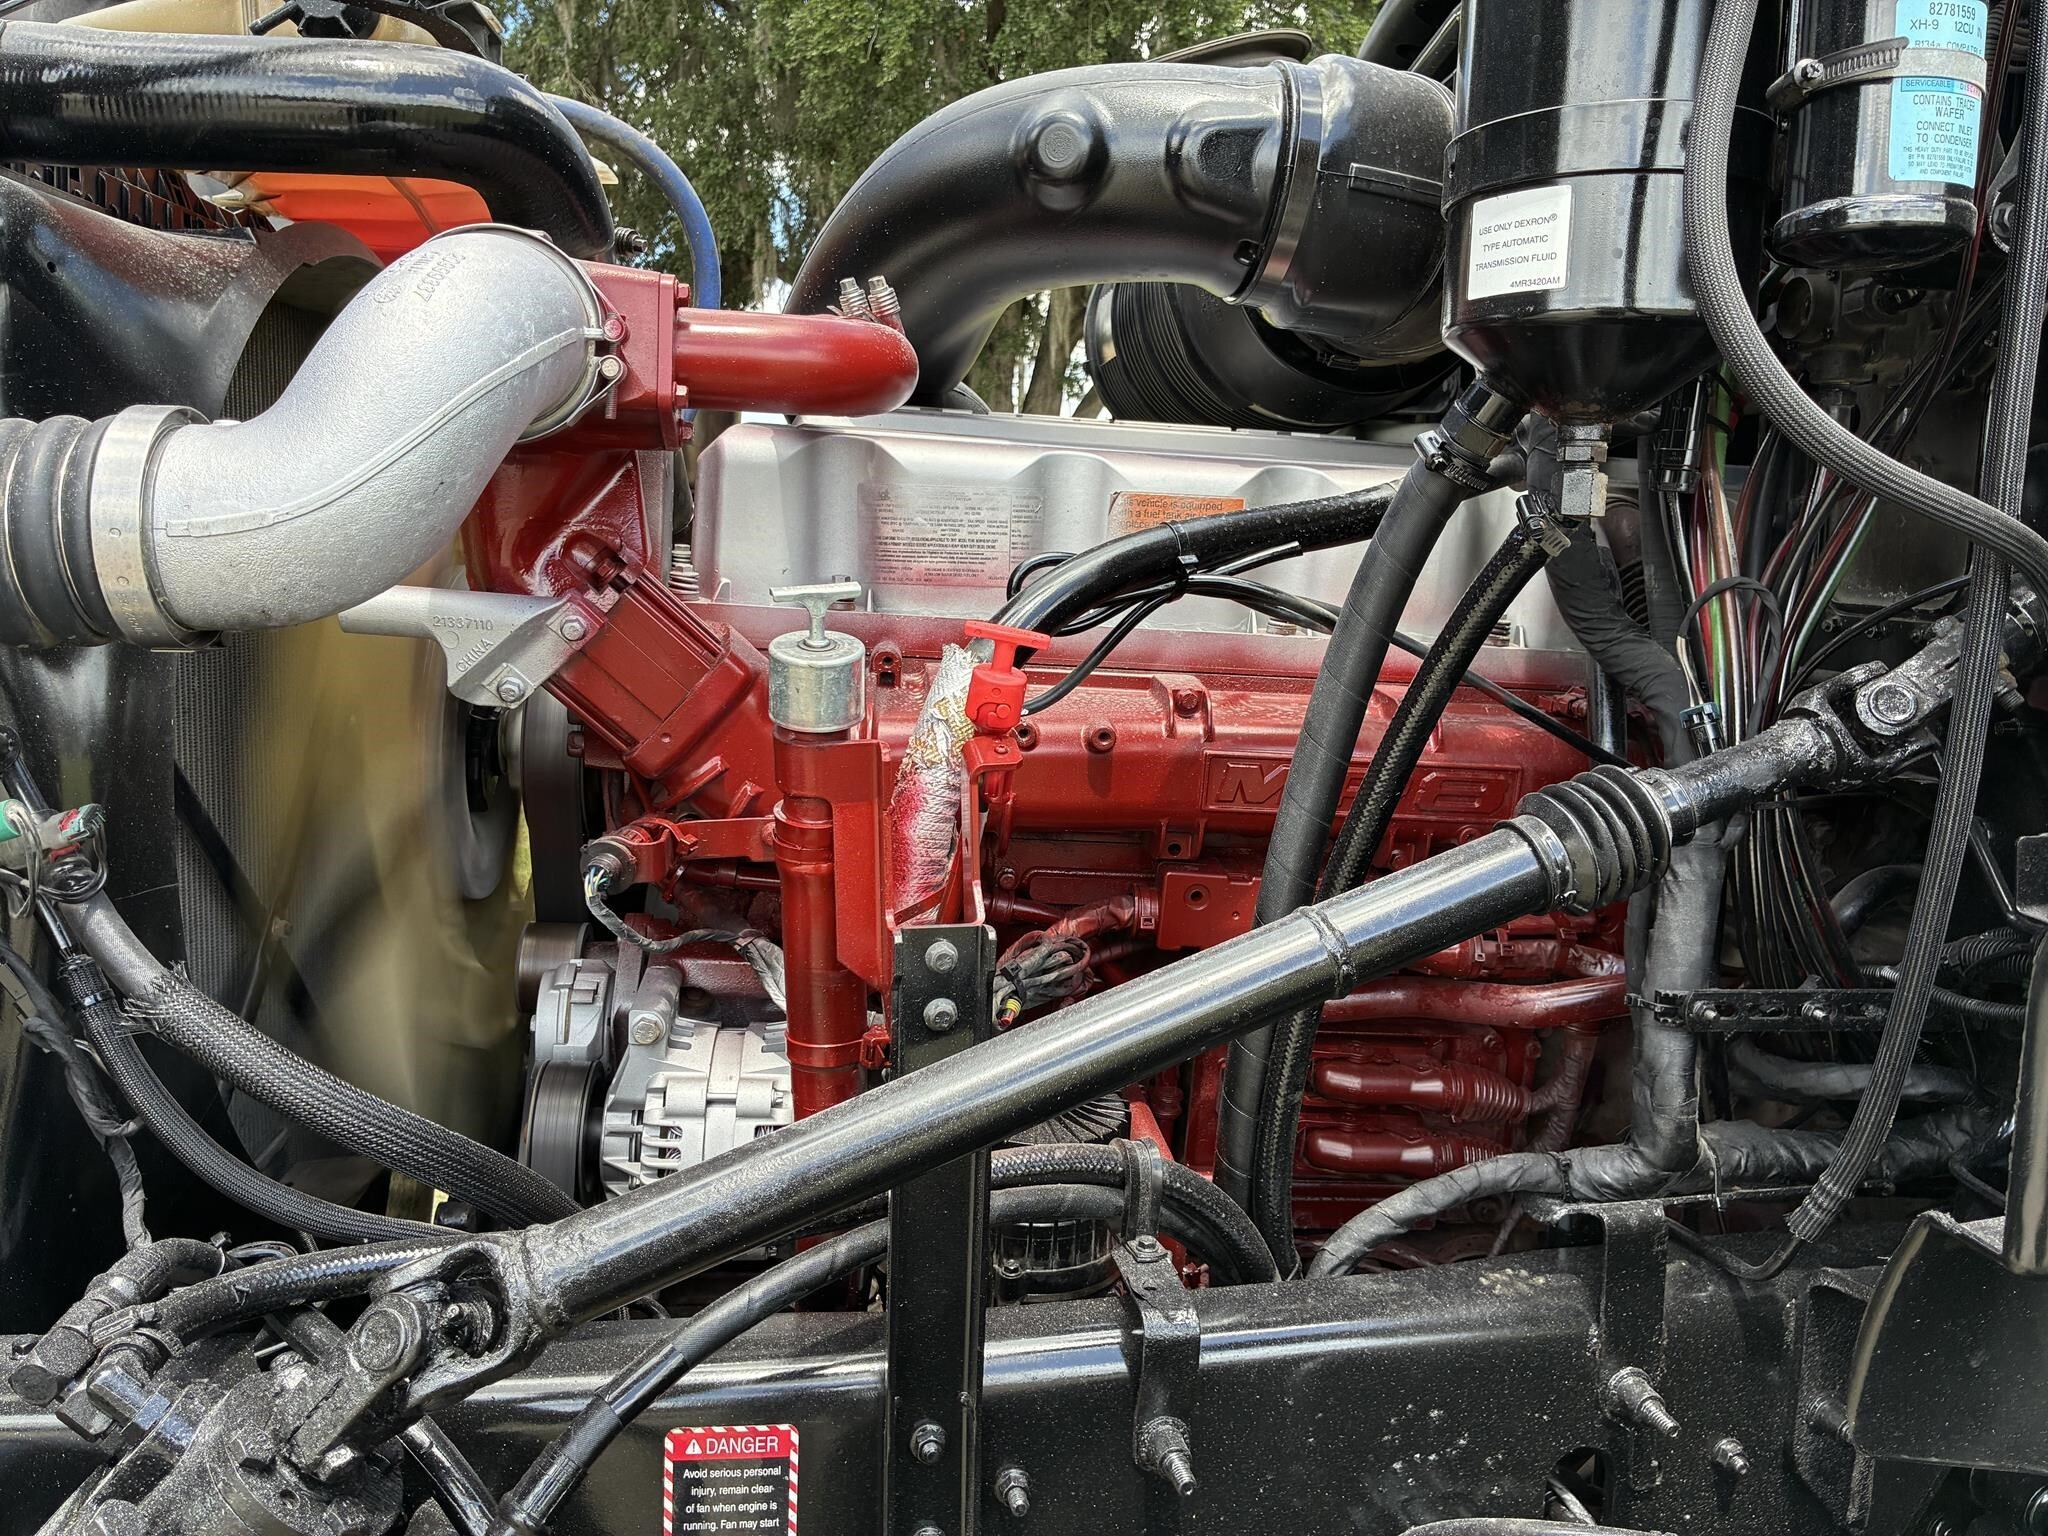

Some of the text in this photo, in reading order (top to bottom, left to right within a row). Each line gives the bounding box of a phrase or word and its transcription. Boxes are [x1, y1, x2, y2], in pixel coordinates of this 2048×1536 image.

[1929, 2, 1976, 21] 82781559
[1910, 18, 1939, 31] XH-9
[1954, 21, 1975, 35] 12CU
[1905, 79, 1951, 88] SERVICEABLE
[1913, 94, 1975, 112] CONTAINS TRACER
[1935, 106, 1965, 120] WAFER
[1916, 121, 1973, 136] CONNECT INLET
[1916, 133, 1972, 149] TO CONDENSER
[1479, 225, 1492, 236] USE
[1493, 222, 1512, 233] ONLY
[1483, 234, 1549, 253] TYPE AUTOMATIC
[1475, 252, 1557, 272] TRANSMISSION FLUID
[1510, 276, 1560, 288] 4MR3420AM
[1136, 498, 1168, 508] vehicle
[1143, 509, 1160, 519] fuel
[432, 615, 494, 631] 21337110
[456, 638, 494, 673] CHINA
[706, 1436, 779, 1454] DANGER
[682, 1466, 781, 1479] Avoid serious personal
[691, 1486, 717, 1498] injury,
[719, 1485, 749, 1495] remain
[685, 1500, 778, 1514] of fan when engine is
[683, 1517, 780, 1532] running. Fan may start
